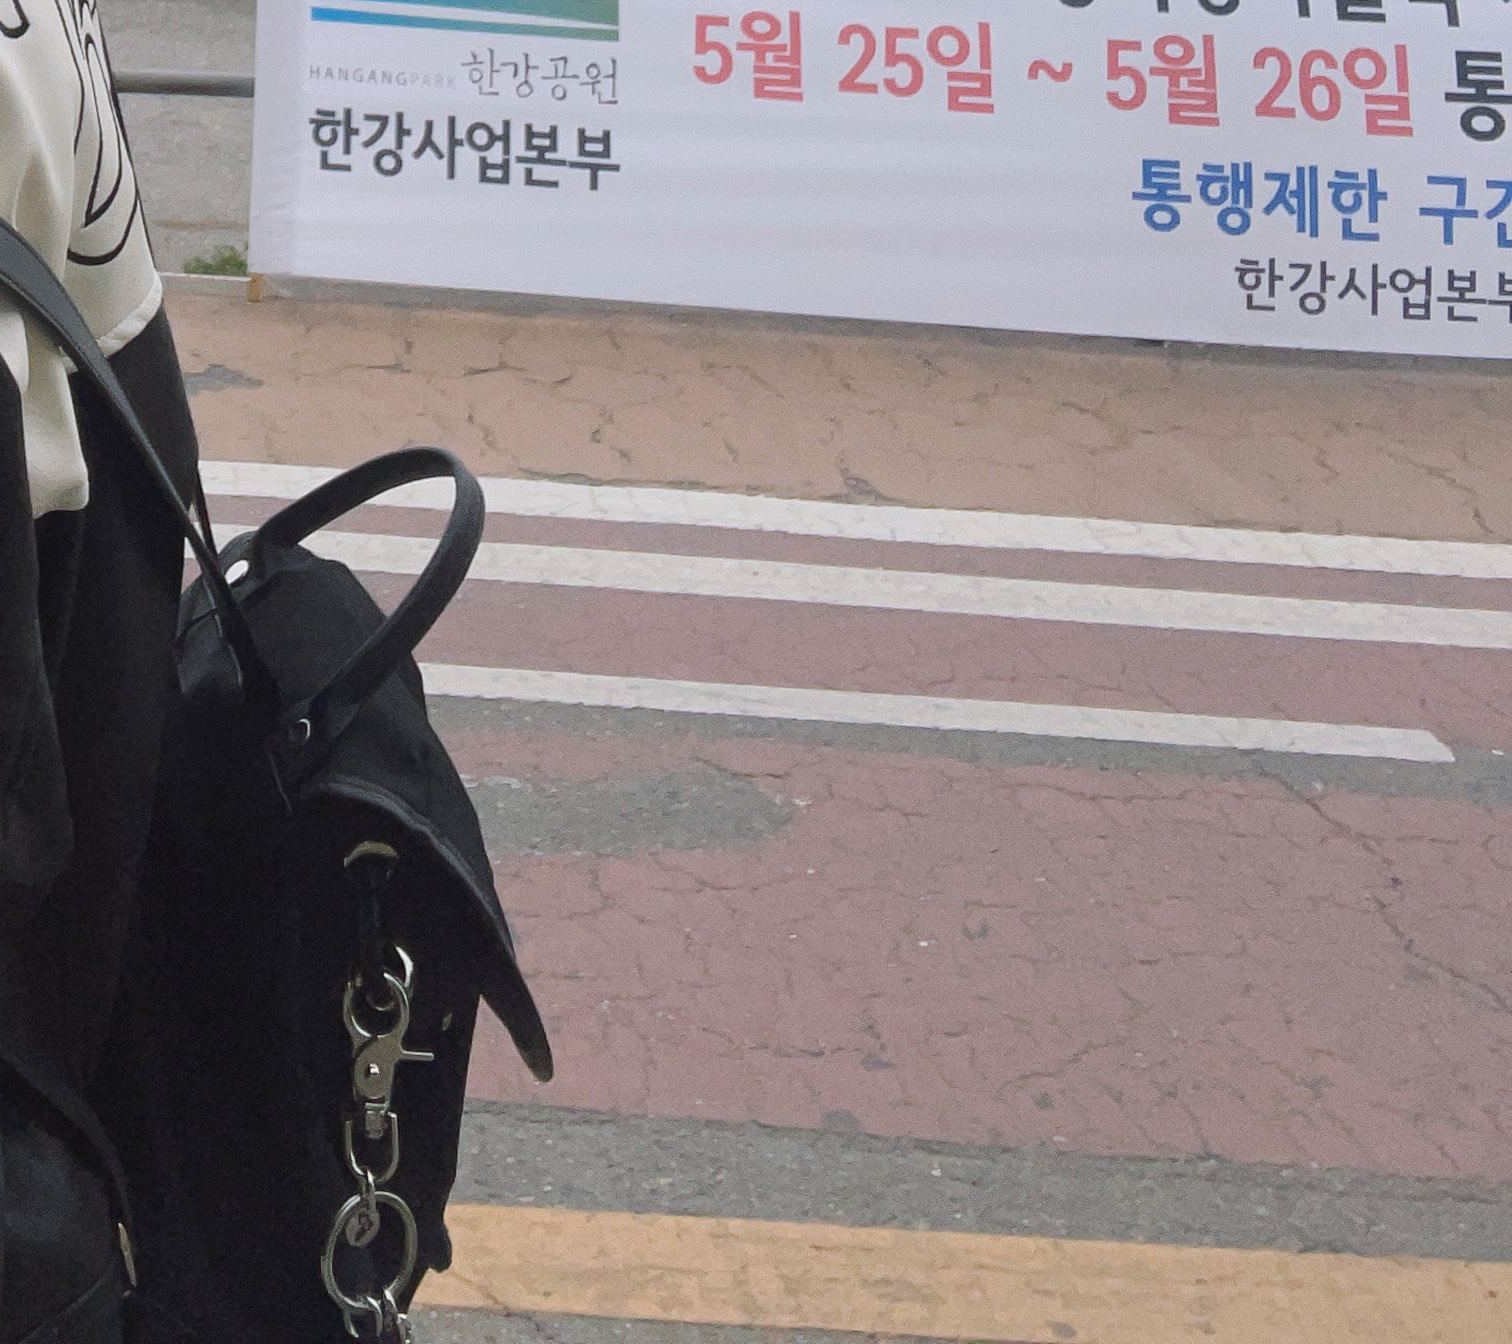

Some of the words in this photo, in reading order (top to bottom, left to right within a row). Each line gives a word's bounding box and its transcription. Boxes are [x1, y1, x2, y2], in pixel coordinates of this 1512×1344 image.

[460, 47, 619, 105] 한강공원
[692, 10, 804, 102] 5월
[837, 21, 995, 114] 25일
[1105, 34, 1221, 127] 5월
[1252, 44, 1414, 137] 26일
[308, 107, 621, 191] 한강사업본부
[1131, 158, 1389, 243] 통행제한
